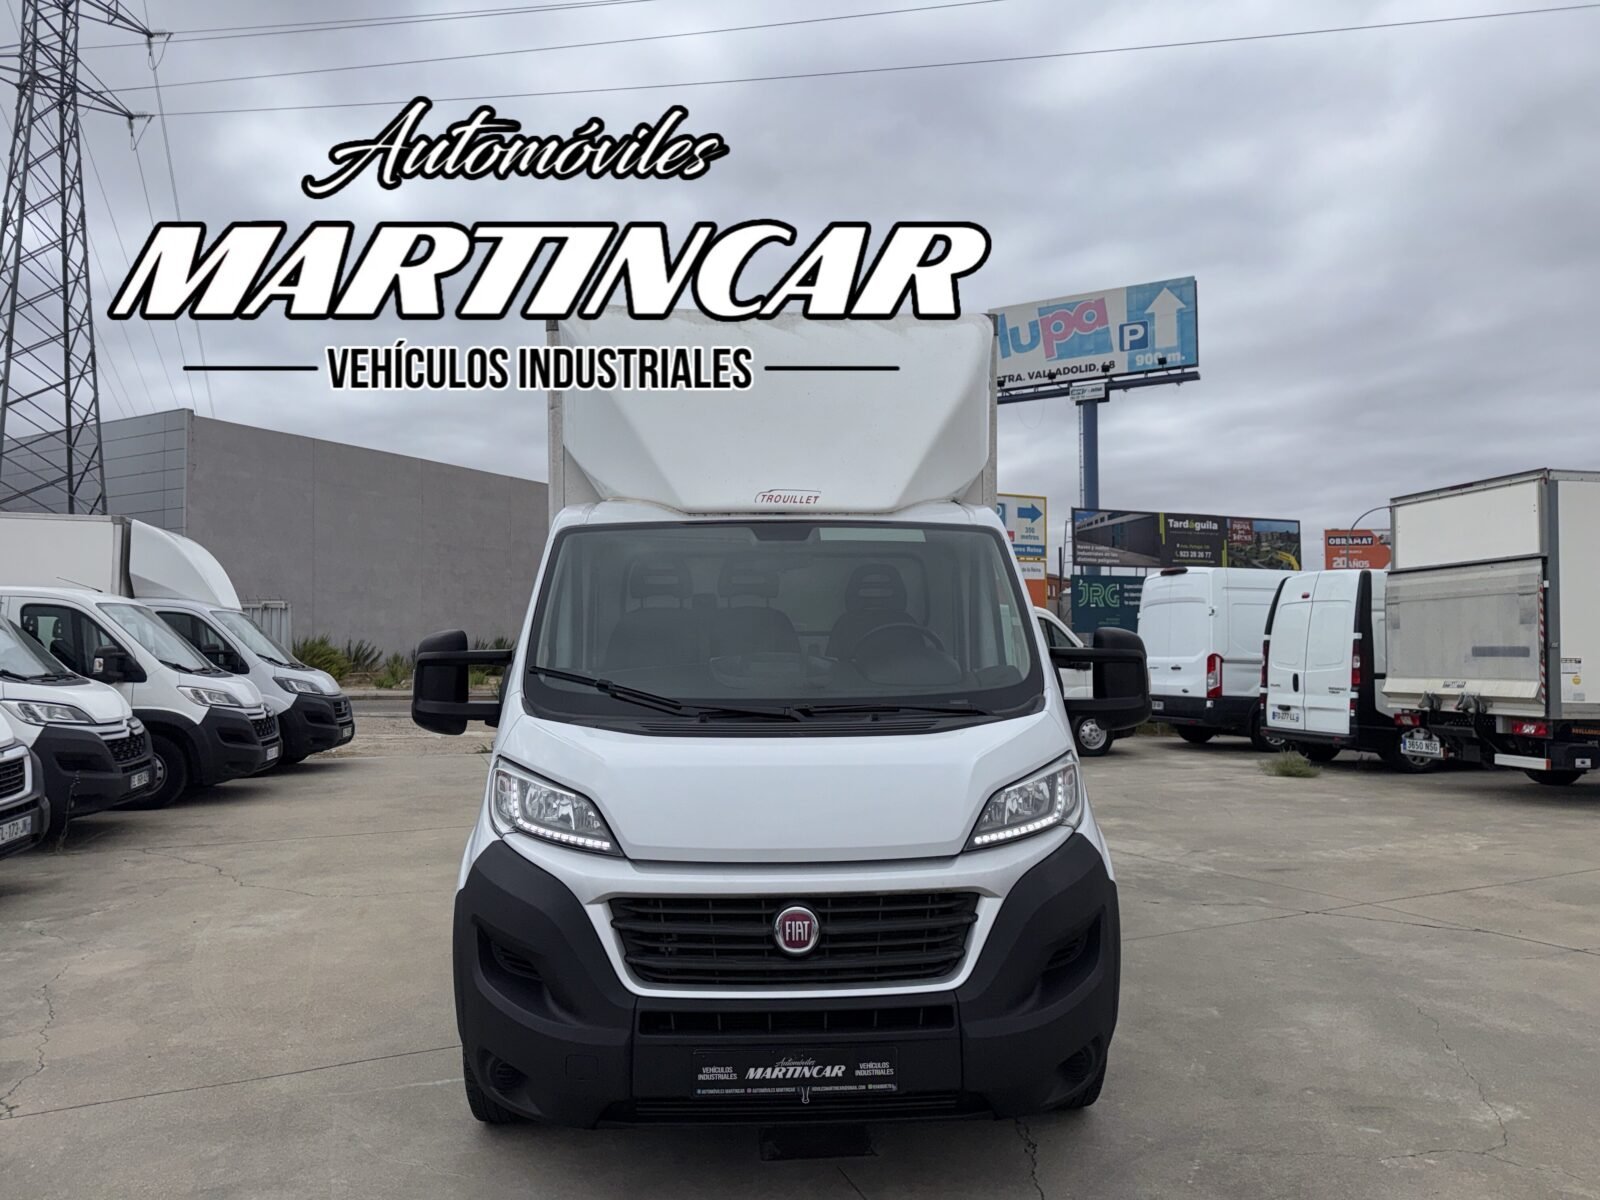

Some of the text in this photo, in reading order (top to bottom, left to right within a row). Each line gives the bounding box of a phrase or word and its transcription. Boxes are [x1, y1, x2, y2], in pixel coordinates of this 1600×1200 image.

[998, 297, 1109, 360] lupa
[760, 494, 820, 504] TROUILLET
[1168, 518, 1218, 531] Tardáguila
[1328, 537, 1373, 545] OBRAMAT
[785, 920, 811, 942] FIAT
[702, 1065, 733, 1073] VEHÍCULOS
[859, 1061, 890, 1069] VEHÍCULOS
[745, 1064, 846, 1080] MARTINCAR
[855, 1068, 894, 1076] INDUSTRIALES
